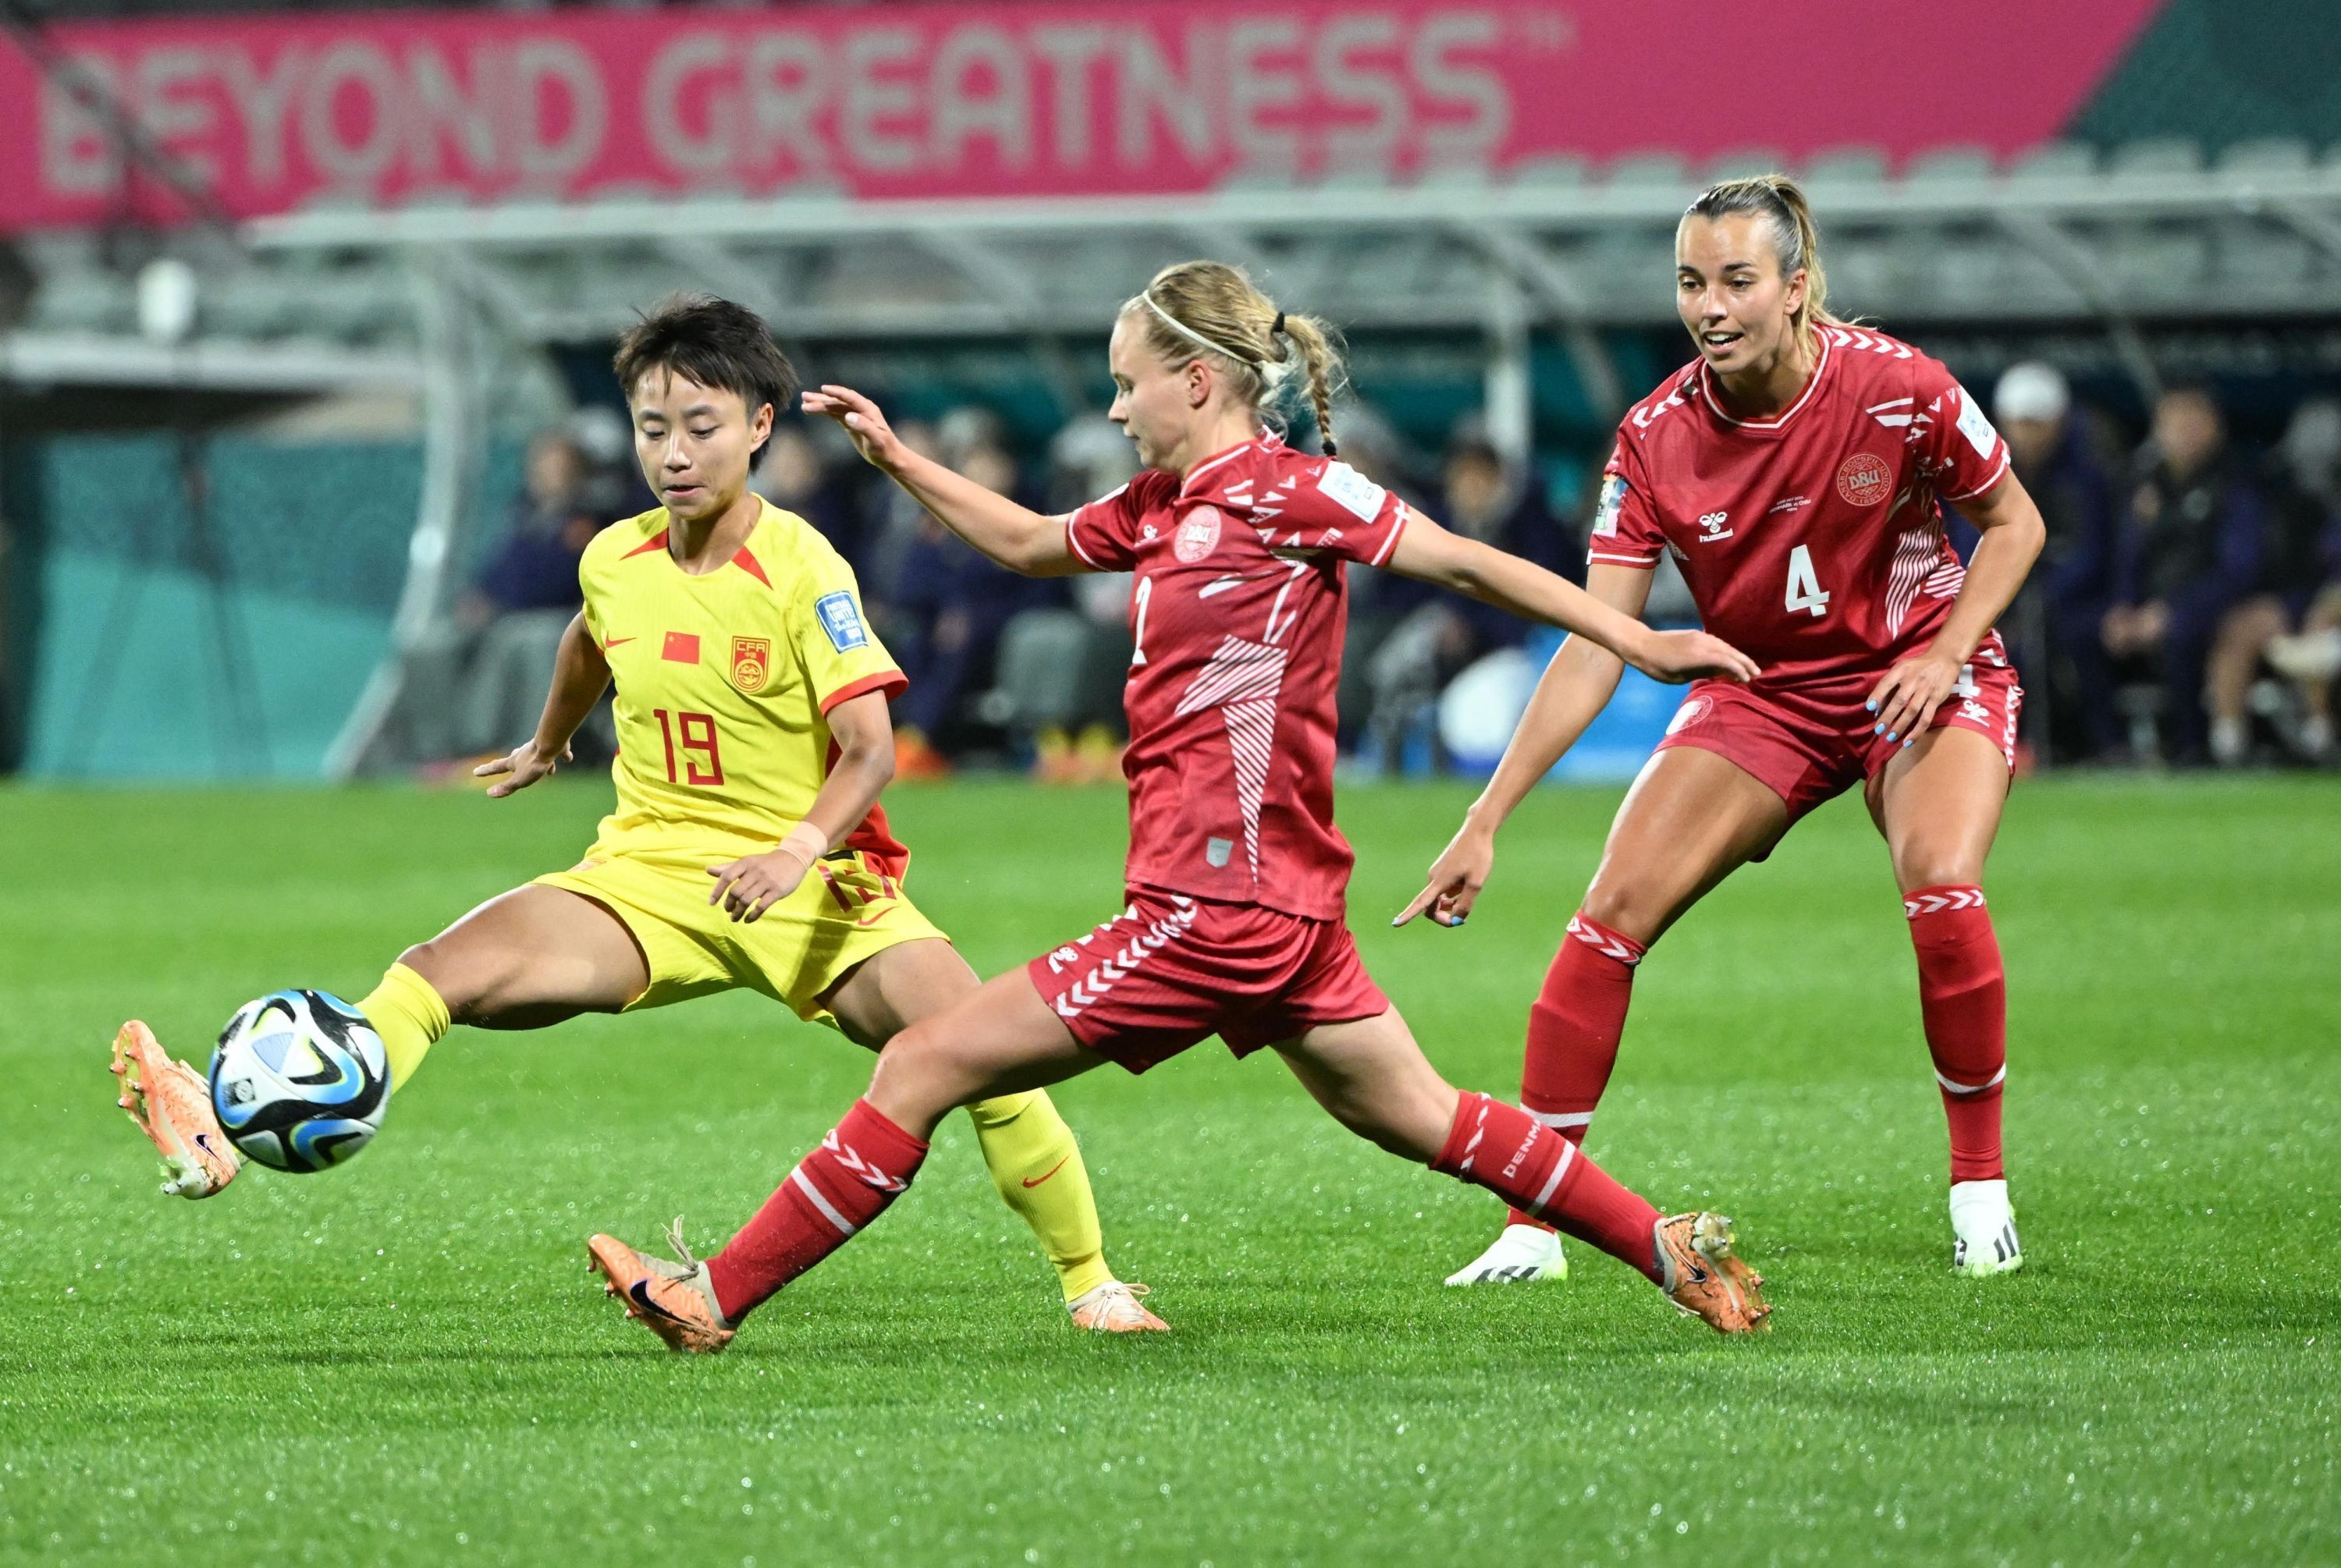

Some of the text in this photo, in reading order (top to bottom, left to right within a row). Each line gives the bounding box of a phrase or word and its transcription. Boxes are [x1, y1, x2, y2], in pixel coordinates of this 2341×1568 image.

[43, 39, 606, 193] BEYOND
[645, 14, 1512, 172] GREATNESS
[1848, 470, 1881, 490] DBU
[1785, 544, 1830, 617] 4
[736, 640, 766, 653] CFA
[653, 708, 724, 786] 19
